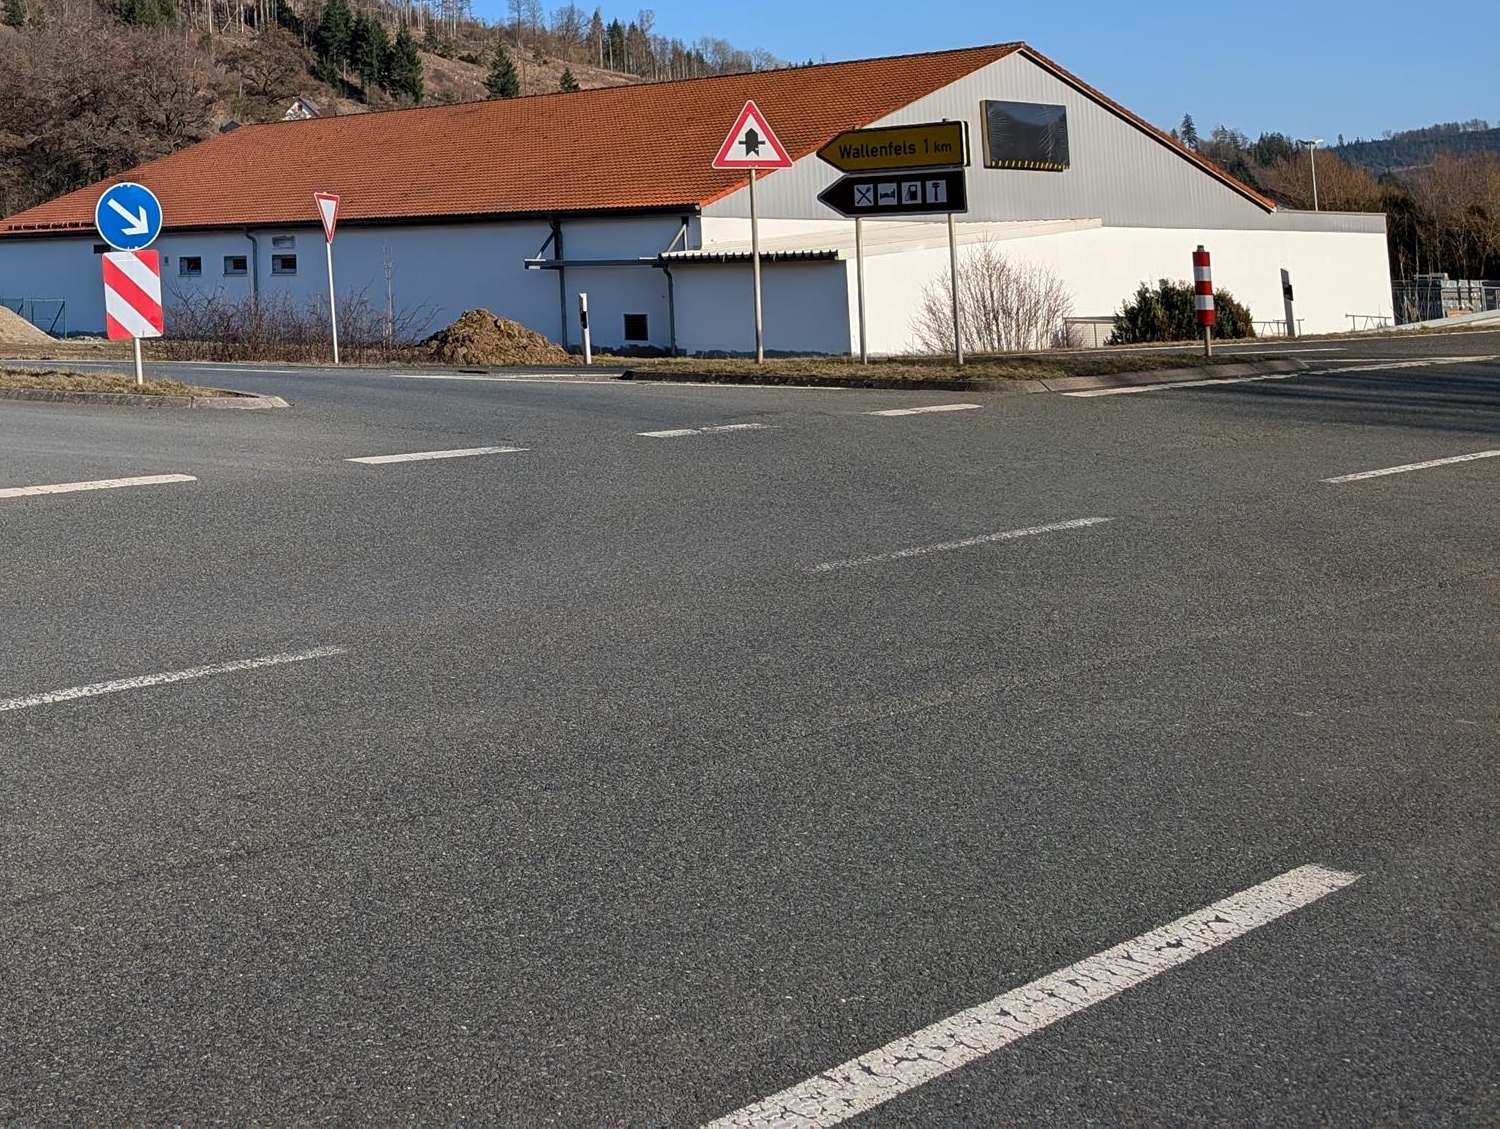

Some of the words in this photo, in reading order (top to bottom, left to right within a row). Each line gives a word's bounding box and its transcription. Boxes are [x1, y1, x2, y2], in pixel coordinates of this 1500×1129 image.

[839, 140, 917, 159] Wallenfels
[923, 138, 929, 154] 1
[934, 141, 952, 153] km
